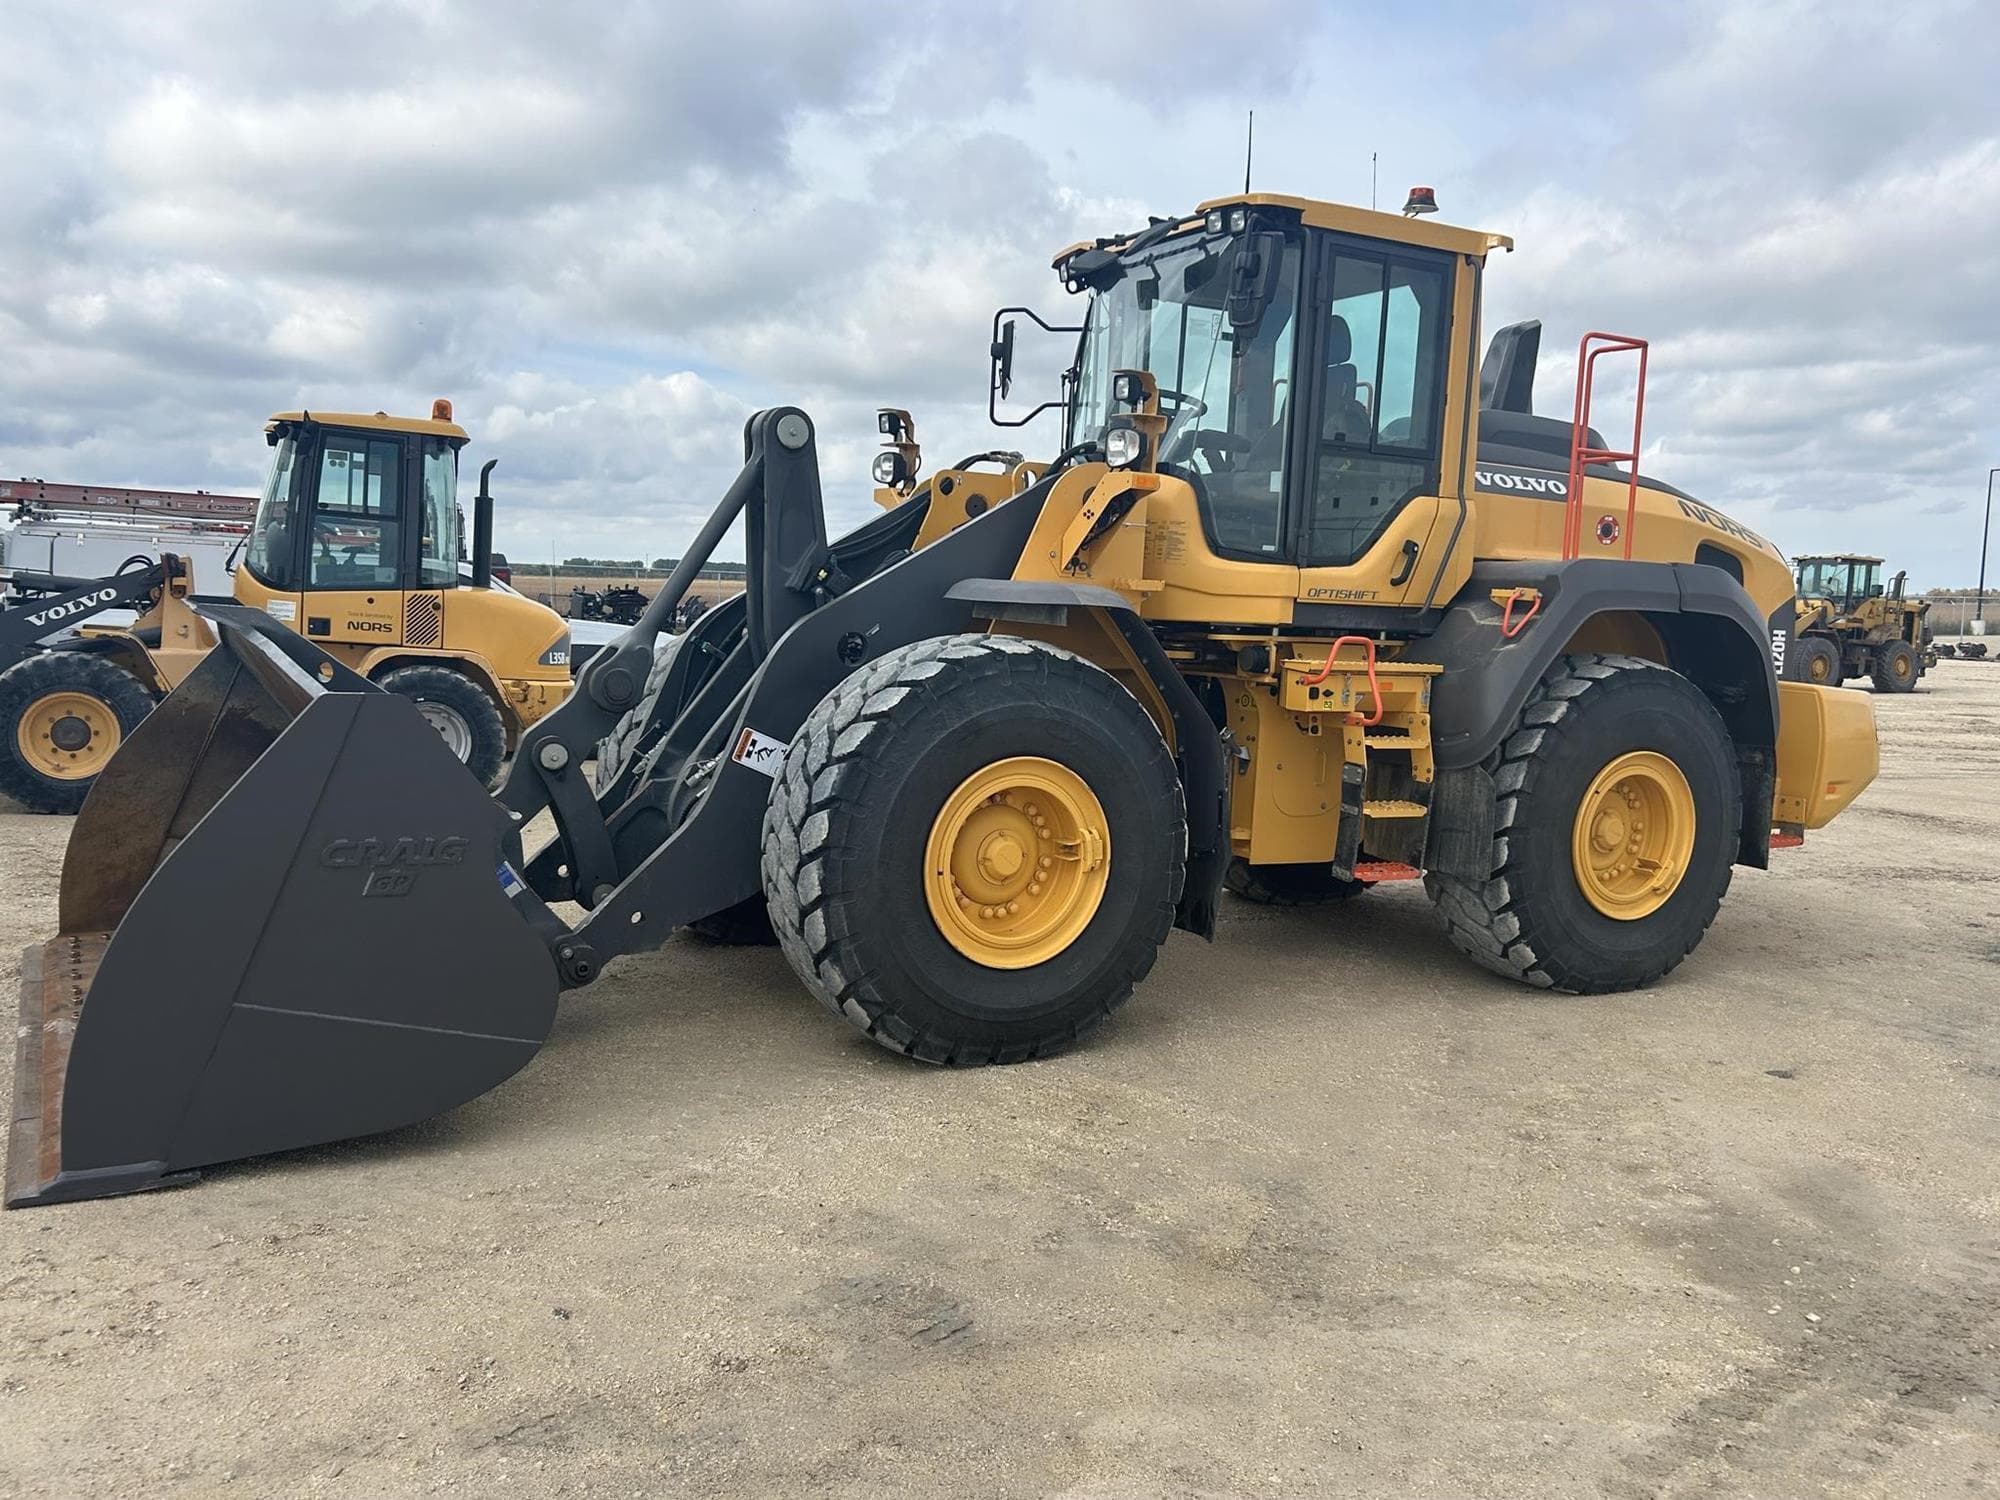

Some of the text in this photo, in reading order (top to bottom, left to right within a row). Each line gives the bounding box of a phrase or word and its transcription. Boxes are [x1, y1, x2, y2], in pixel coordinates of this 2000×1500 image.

[1474, 471, 1567, 495] VOLVO
[1677, 499, 1763, 549] NORS
[24, 588, 117, 626] VOLVO
[1307, 587, 1379, 600] OPTISHIFT
[347, 620, 393, 633] NORS
[1771, 629, 1787, 675] L120H
[320, 836, 469, 868] CRAIG
